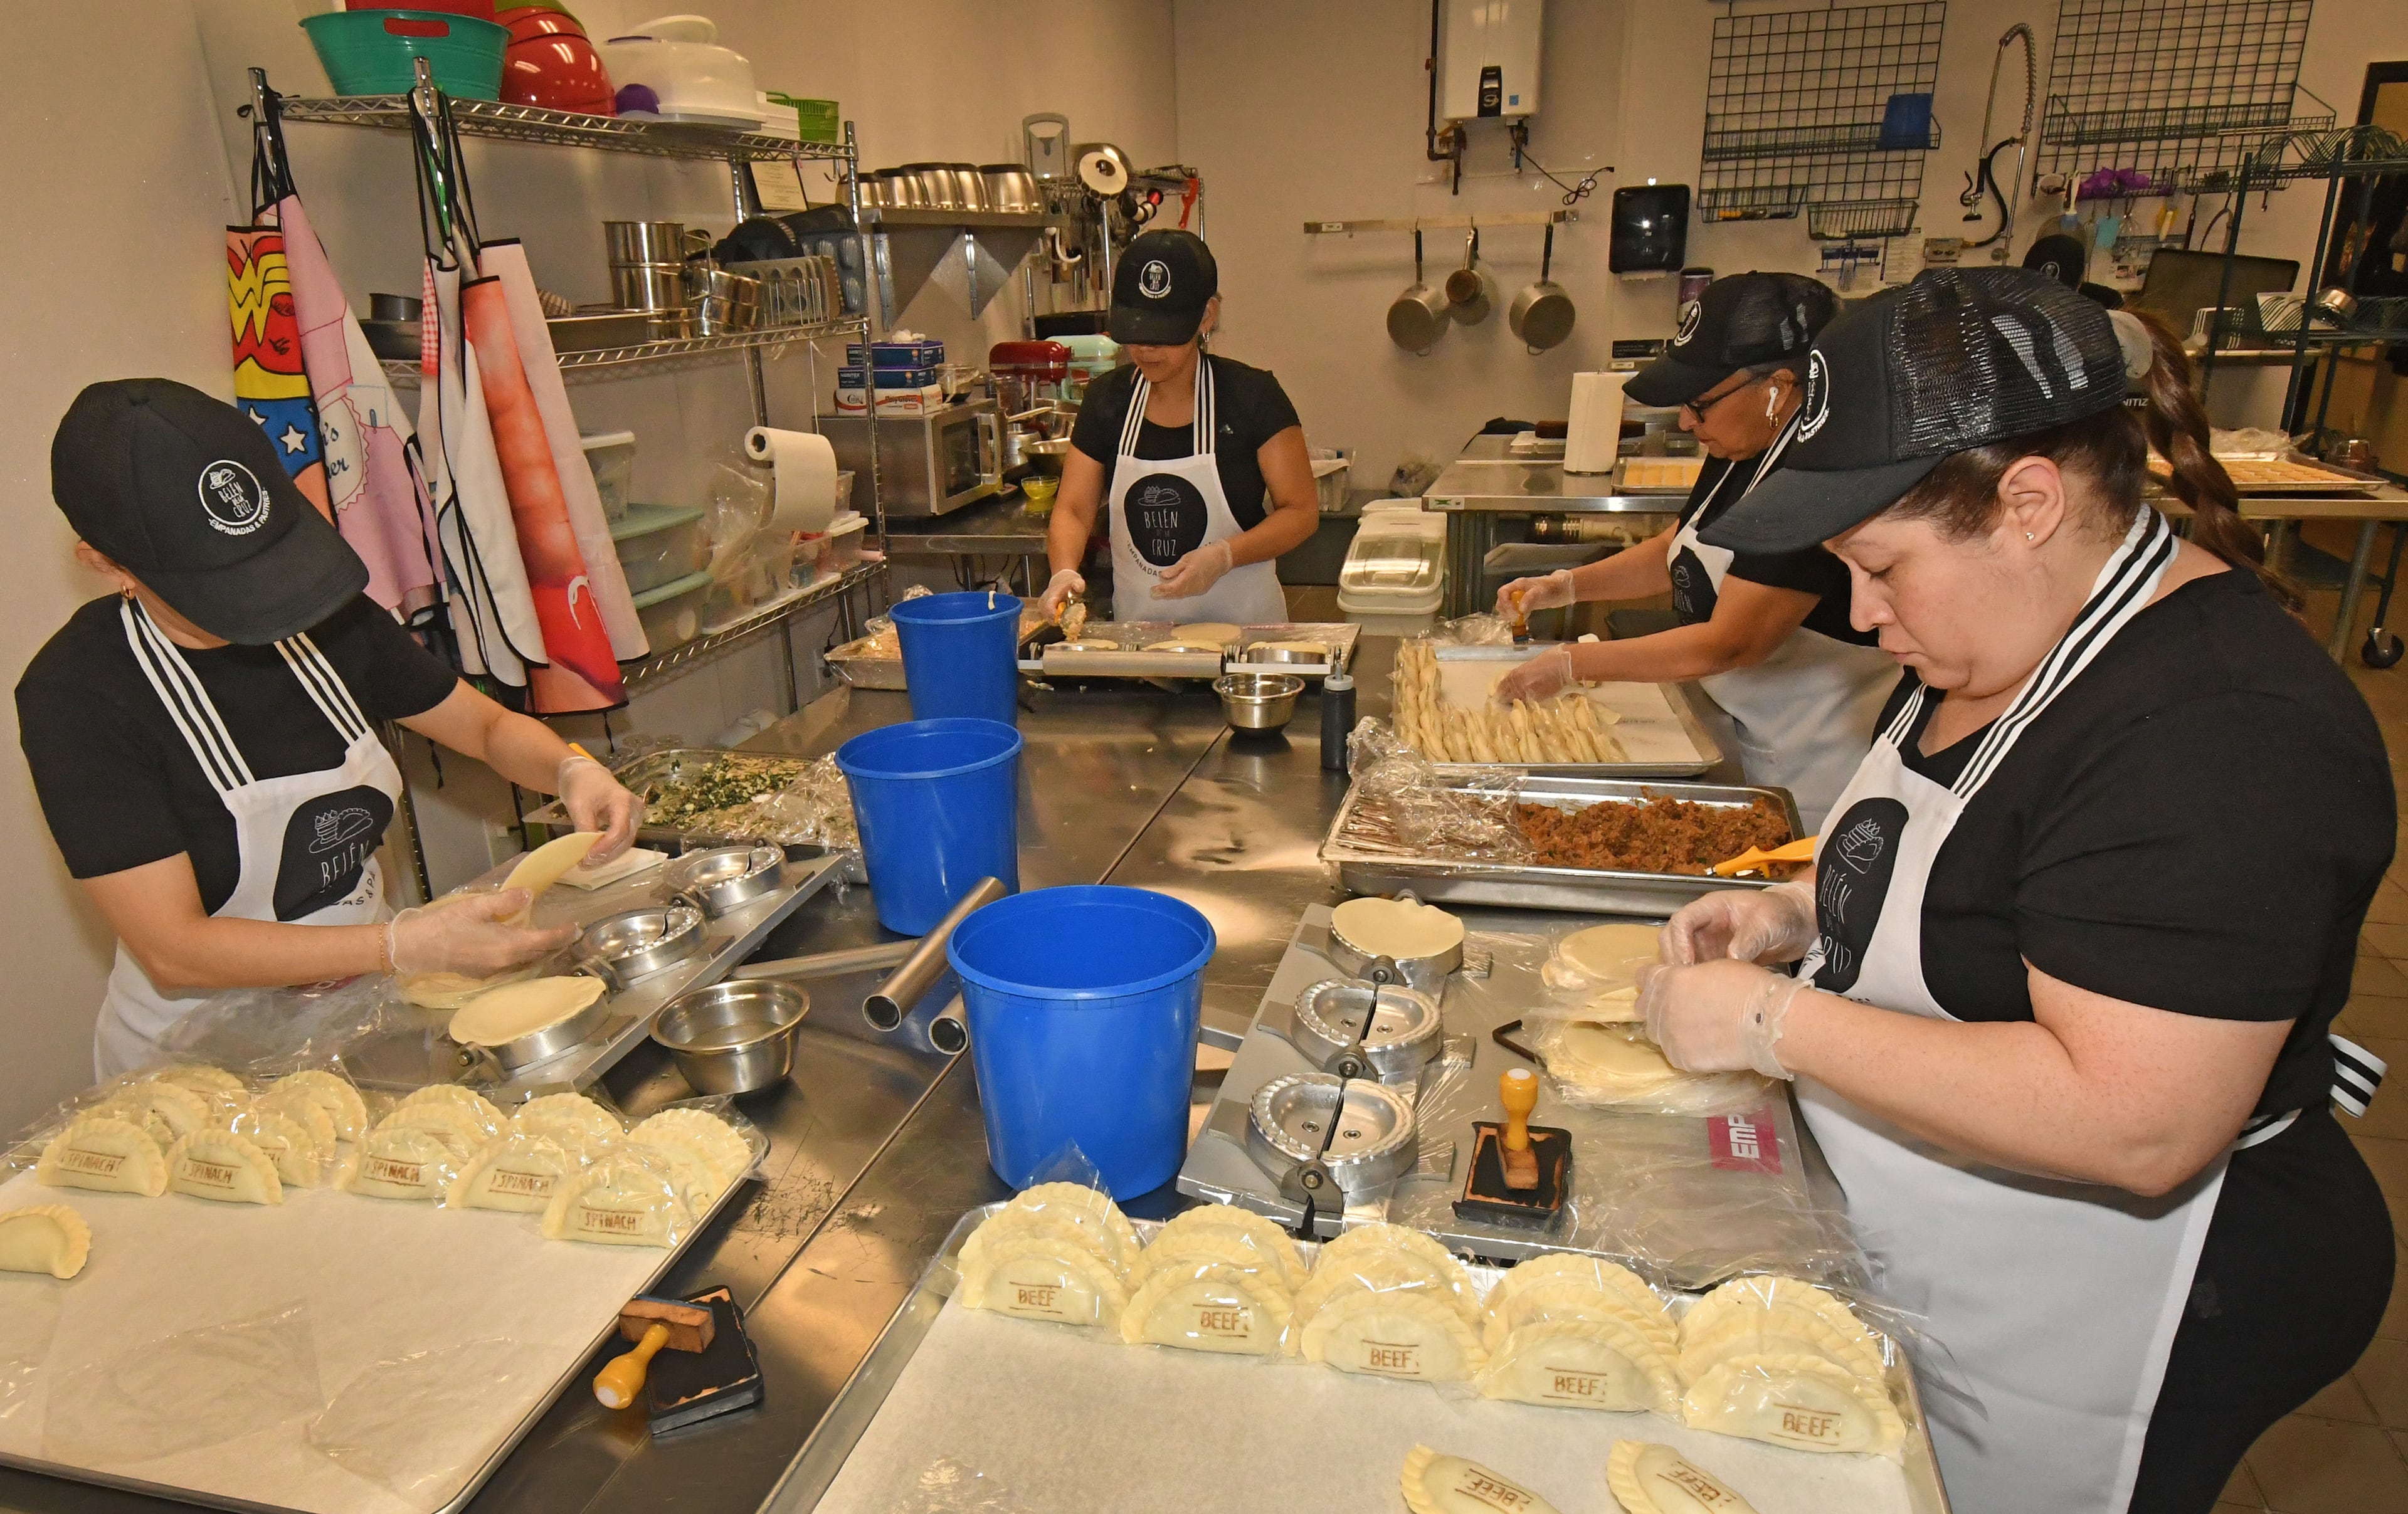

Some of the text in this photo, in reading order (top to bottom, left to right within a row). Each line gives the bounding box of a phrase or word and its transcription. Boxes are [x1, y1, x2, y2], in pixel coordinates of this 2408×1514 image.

[233, 500, 253, 518] CRUZ
[1144, 508, 1178, 528] BELÉN
[1152, 539, 1176, 557] CRUZ
